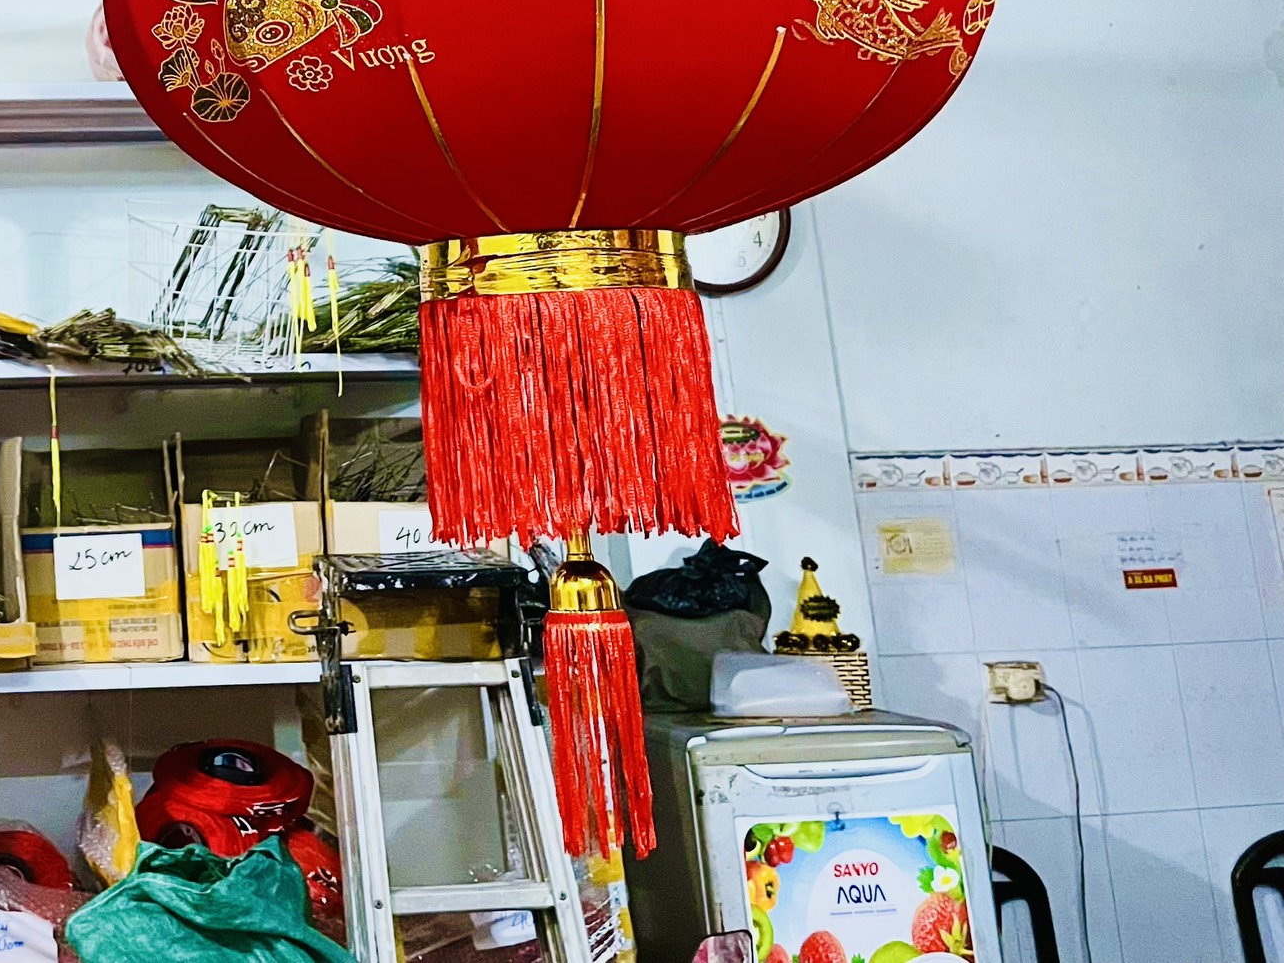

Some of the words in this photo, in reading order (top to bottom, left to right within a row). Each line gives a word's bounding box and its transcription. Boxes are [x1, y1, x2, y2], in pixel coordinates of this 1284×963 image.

[331, 39, 436, 71] Vượng
[753, 230, 763, 247] 4
[834, 862, 879, 878] SANYO
[837, 884, 887, 905] AQUA
